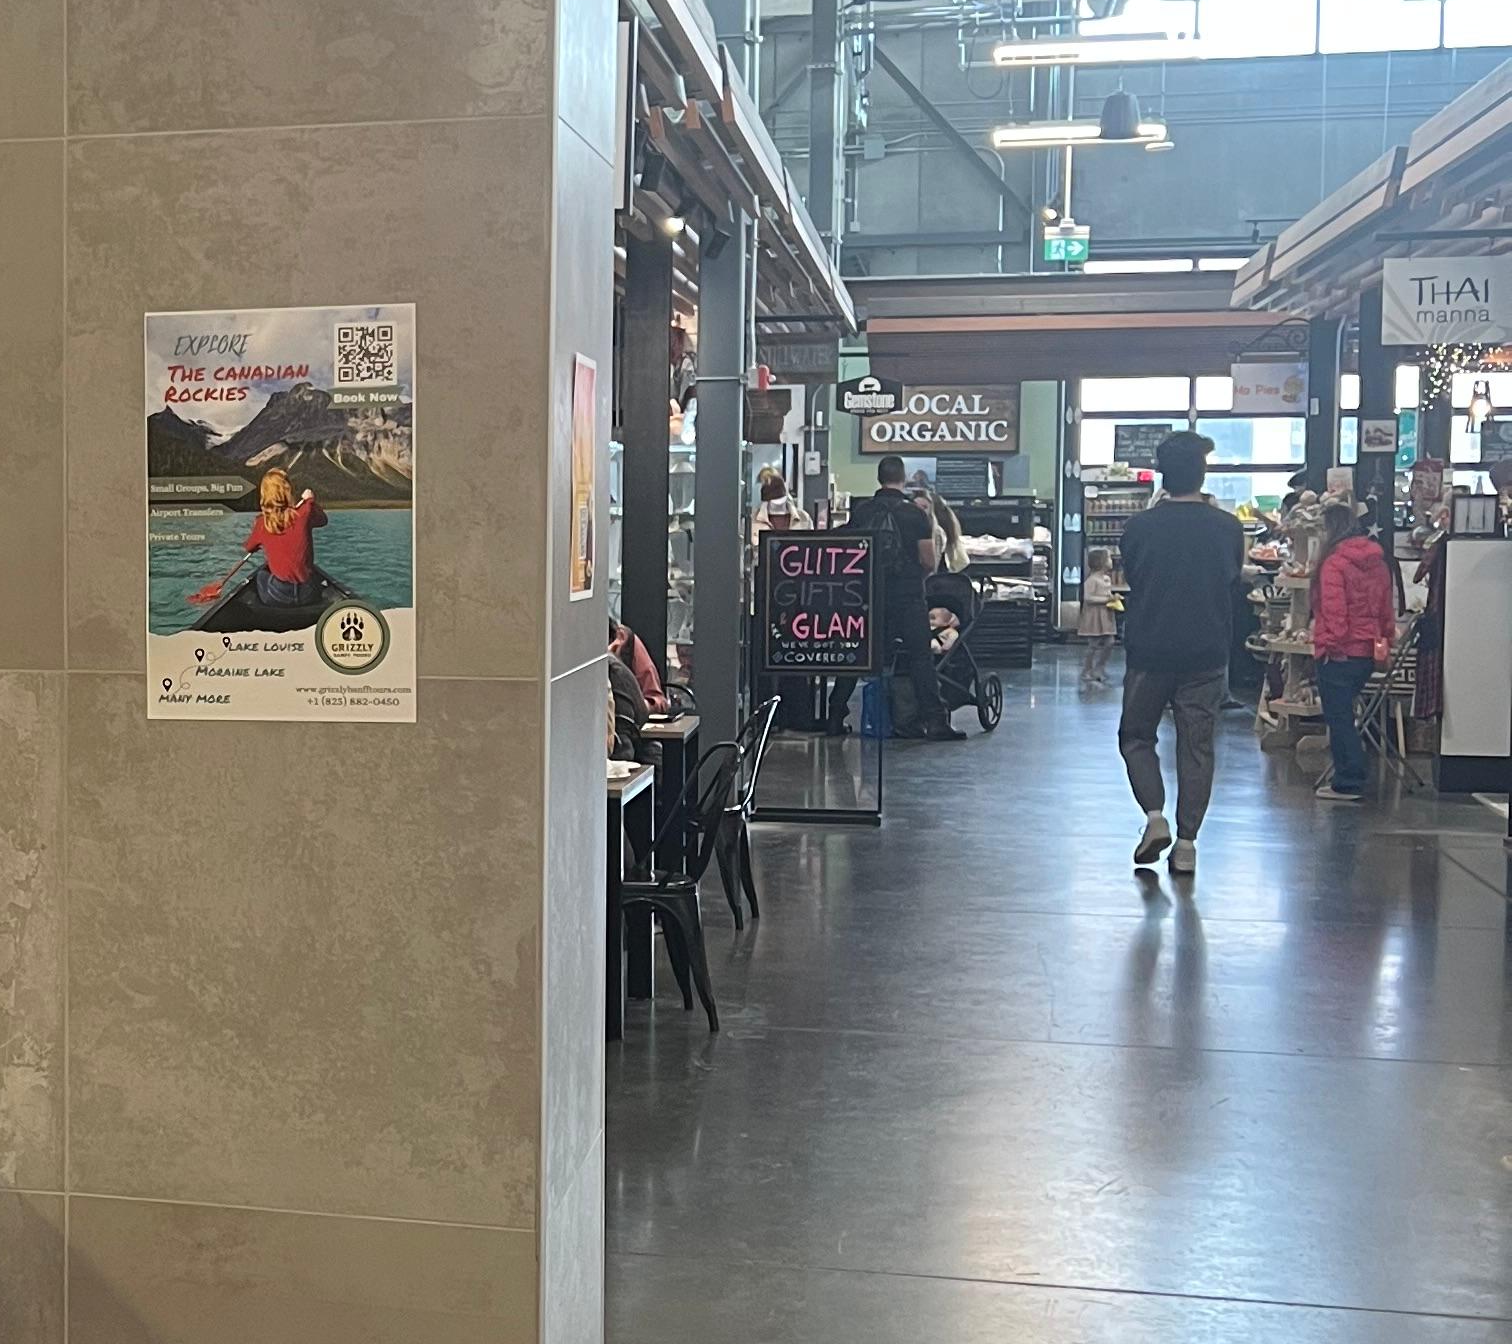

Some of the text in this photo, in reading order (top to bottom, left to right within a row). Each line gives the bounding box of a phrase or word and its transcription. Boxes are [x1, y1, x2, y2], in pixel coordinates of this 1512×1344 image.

[1409, 276, 1489, 305] THAI
[1416, 309, 1490, 323] manna
[174, 333, 253, 357] EXPLORE
[168, 364, 309, 382] THE CANADIAN
[164, 386, 250, 403] ROCKIES
[333, 392, 399, 404] Book Now
[870, 421, 1009, 443] ORGANIC
[150, 483, 175, 493] Small
[210, 483, 225, 494] Big
[226, 483, 243, 492] Fun
[150, 508, 224, 518] Airport Transfers
[149, 533, 206, 541] Private Tours
[780, 545, 867, 576] GLITZ
[774, 580, 863, 607] GIFTS
[792, 612, 865, 639] GLAM
[228, 642, 304, 652] LAKE LOUISE
[331, 643, 374, 652] GRIZZLY
[813, 640, 834, 649] GOT
[784, 651, 845, 663] COVERED
[195, 666, 285, 678] MORAINE LAKE
[158, 694, 231, 704] MANY MORE
[307, 697, 319, 706] +1
[321, 696, 347, 707] (825)
